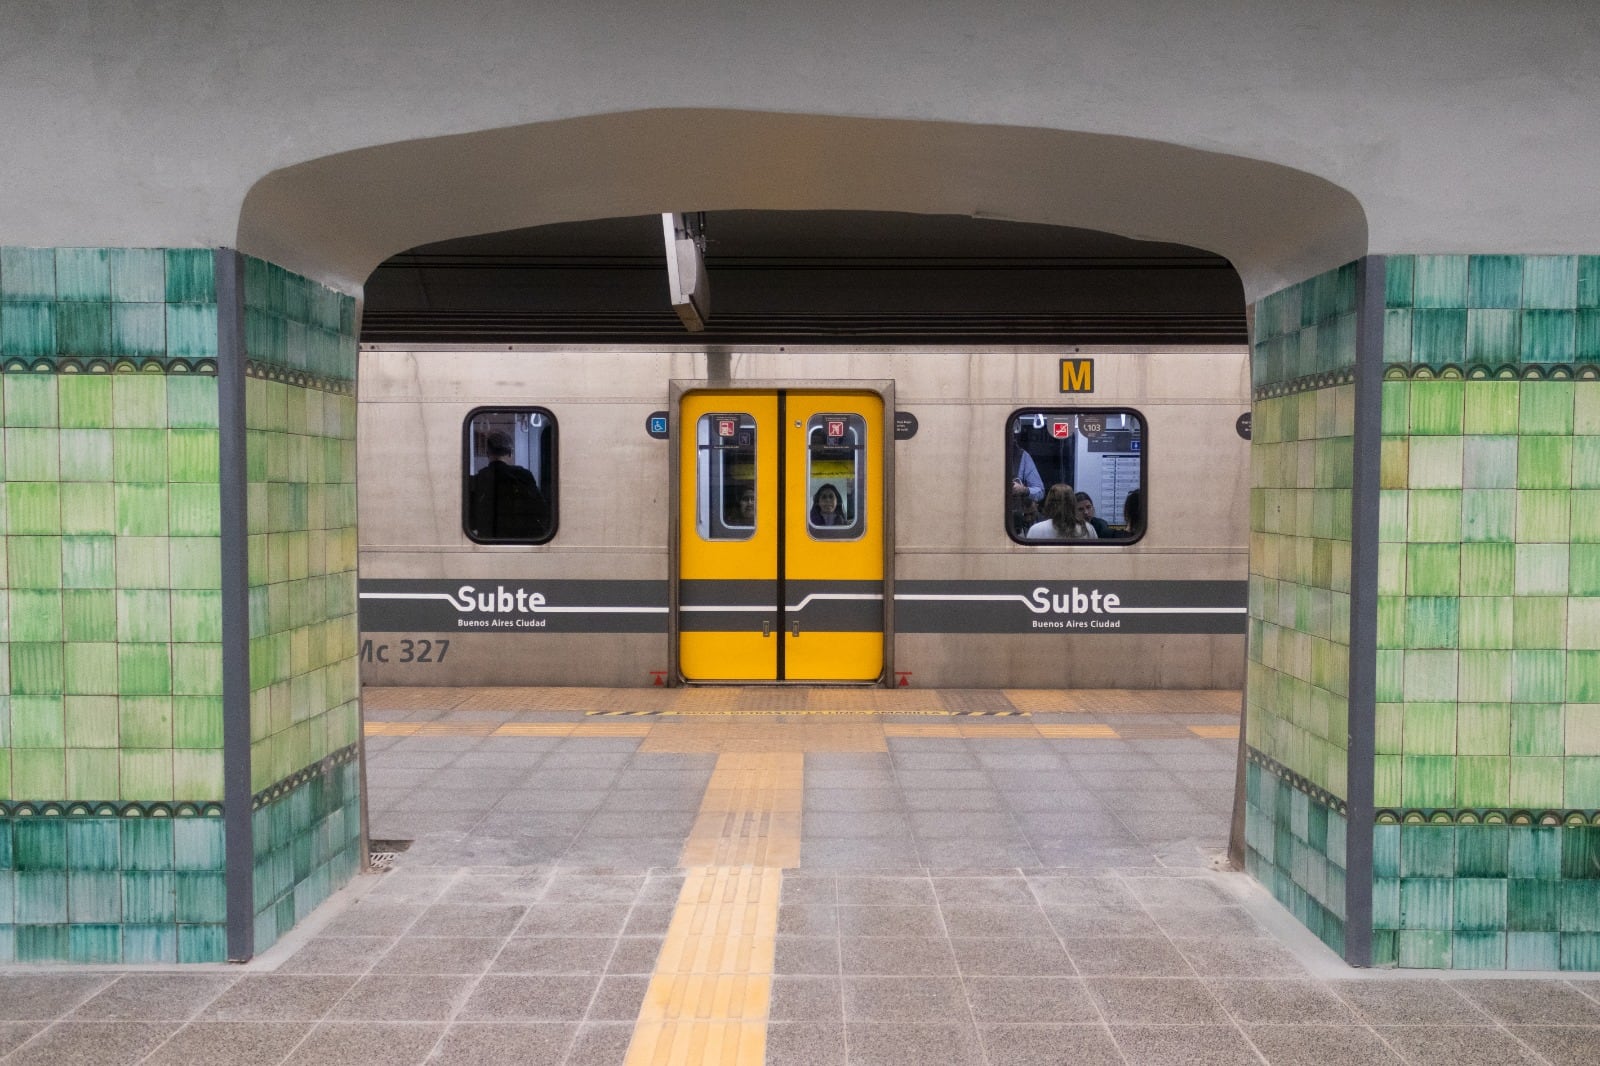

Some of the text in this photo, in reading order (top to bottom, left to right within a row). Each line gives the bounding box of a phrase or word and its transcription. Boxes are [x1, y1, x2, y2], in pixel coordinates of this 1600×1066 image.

[1062, 361, 1091, 391] M
[1088, 423, 1101, 432] 103
[457, 585, 546, 613] Subte
[1032, 587, 1120, 613] Subte
[457, 618, 546, 627] Buenos Aires Ciudad
[1032, 620, 1120, 628] Buenos Aires Ciudad
[399, 639, 450, 663] 327
